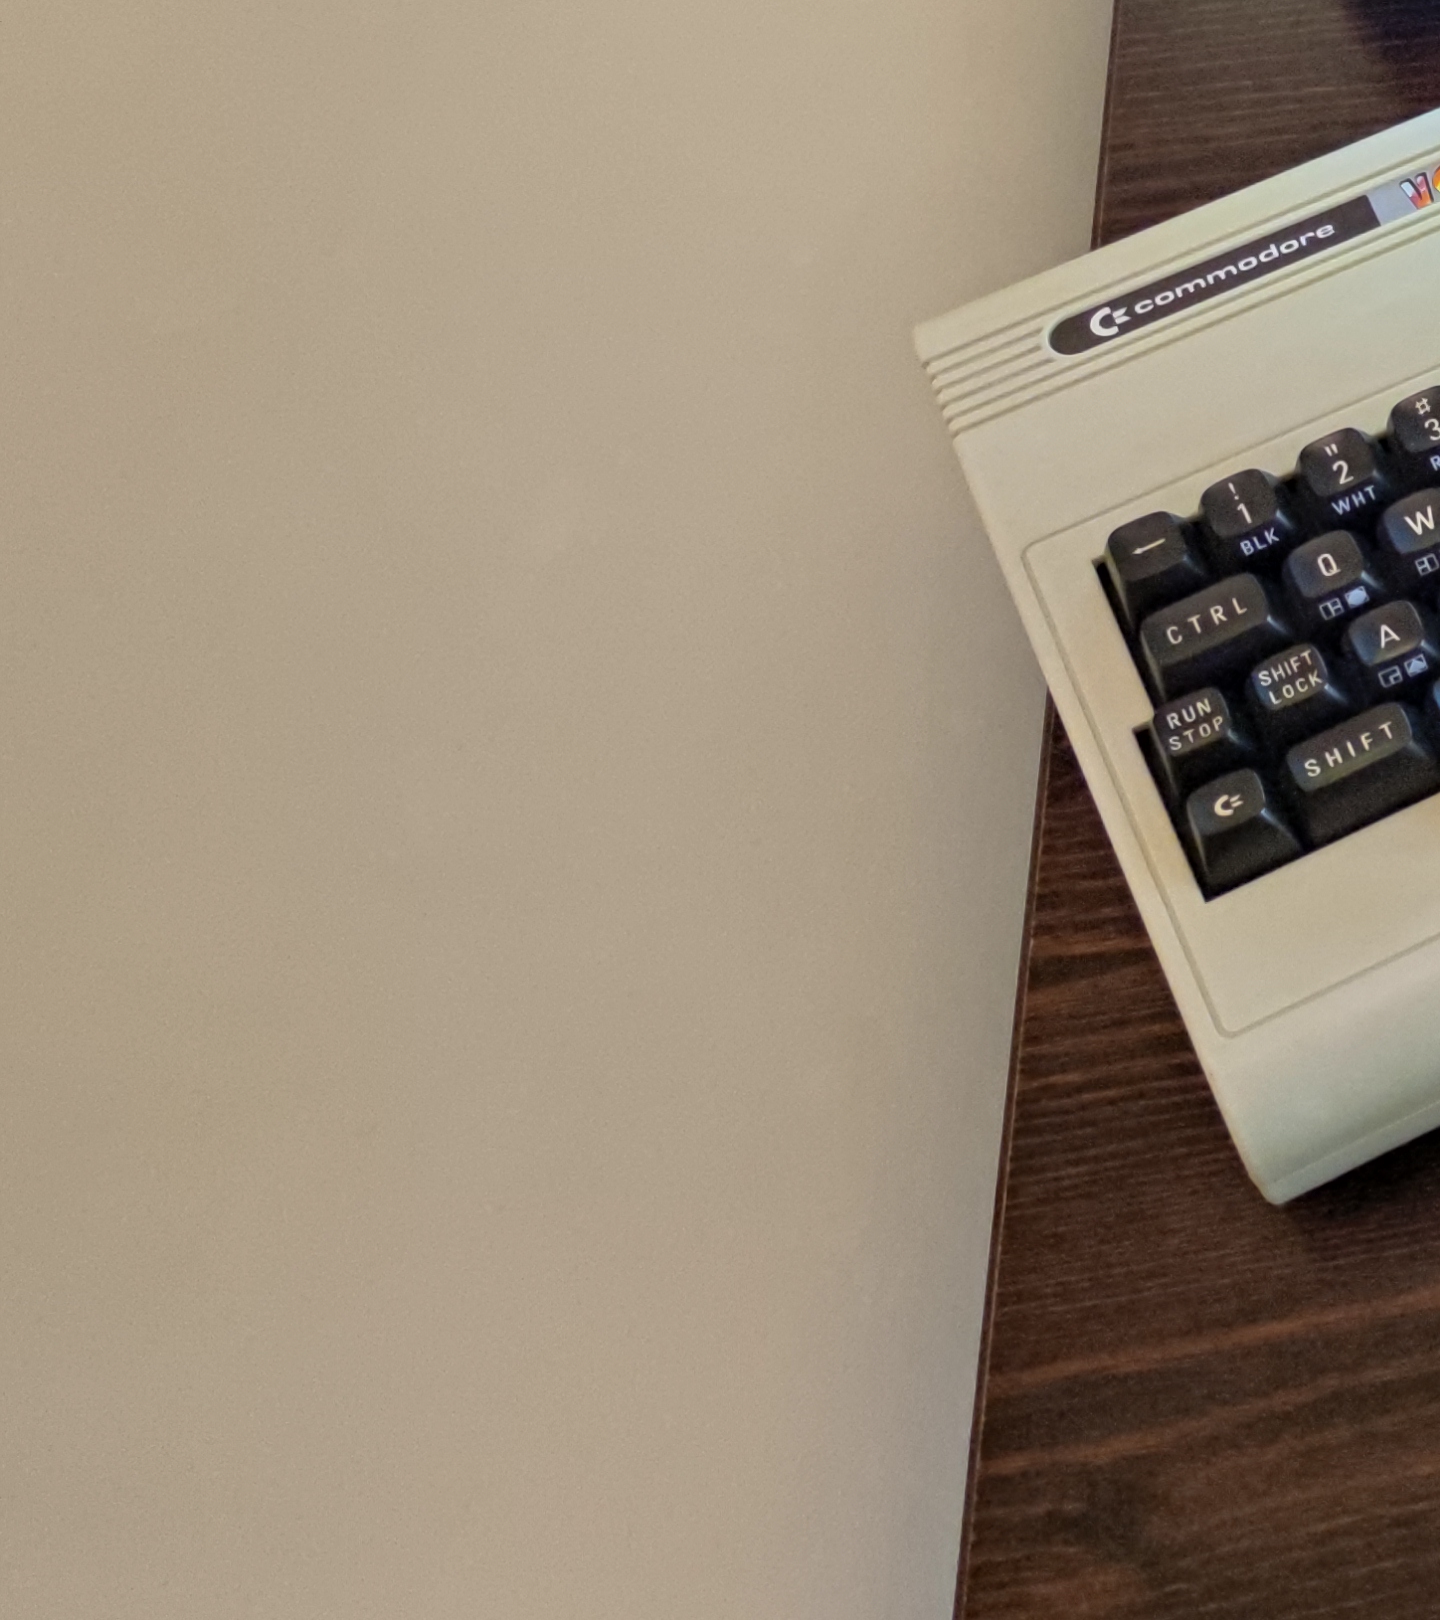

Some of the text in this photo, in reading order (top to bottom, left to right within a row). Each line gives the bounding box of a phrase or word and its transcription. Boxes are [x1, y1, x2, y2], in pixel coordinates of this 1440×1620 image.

[1133, 223, 1335, 315] commodore
[1330, 485, 1379, 515] WHT
[1239, 529, 1280, 556] BLK
[1165, 596, 1249, 645] CTRL
[1258, 650, 1314, 686] SHIFT
[1268, 669, 1322, 704] LOCK
[1165, 696, 1212, 729] RUN
[1168, 716, 1225, 751] STOP
[1304, 720, 1395, 778] SHIFT
